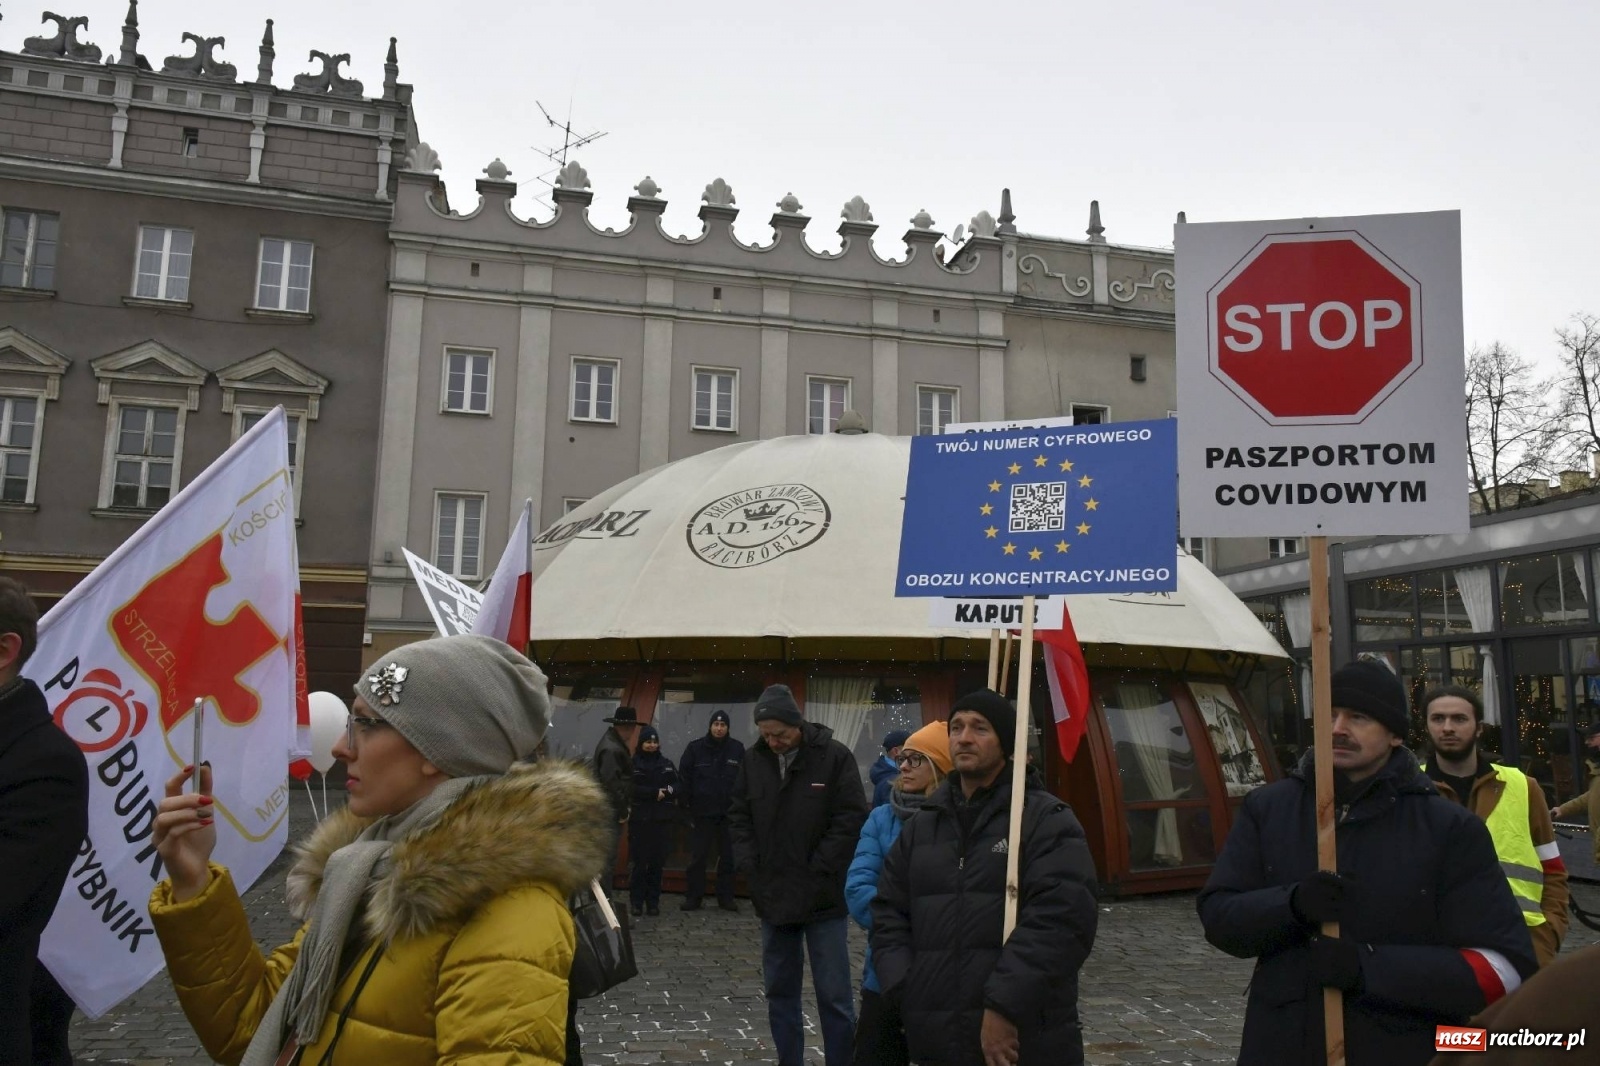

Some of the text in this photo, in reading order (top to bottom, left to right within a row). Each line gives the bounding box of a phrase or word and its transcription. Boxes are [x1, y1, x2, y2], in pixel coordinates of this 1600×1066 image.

[1223, 299, 1403, 352] STOP
[936, 429, 1152, 453] TWÓJ NUMER CYFROWEGO
[1205, 442, 1435, 468] PASZPORTOM
[703, 490, 762, 518] BROWAR
[1215, 480, 1427, 506] COVIDOWYM
[760, 510, 816, 534] 1567
[699, 534, 798, 564] RACIBÓRZ
[414, 560, 482, 607] MEDIA
[905, 567, 1170, 586] OBOZU KONCENTRACYJNEGO
